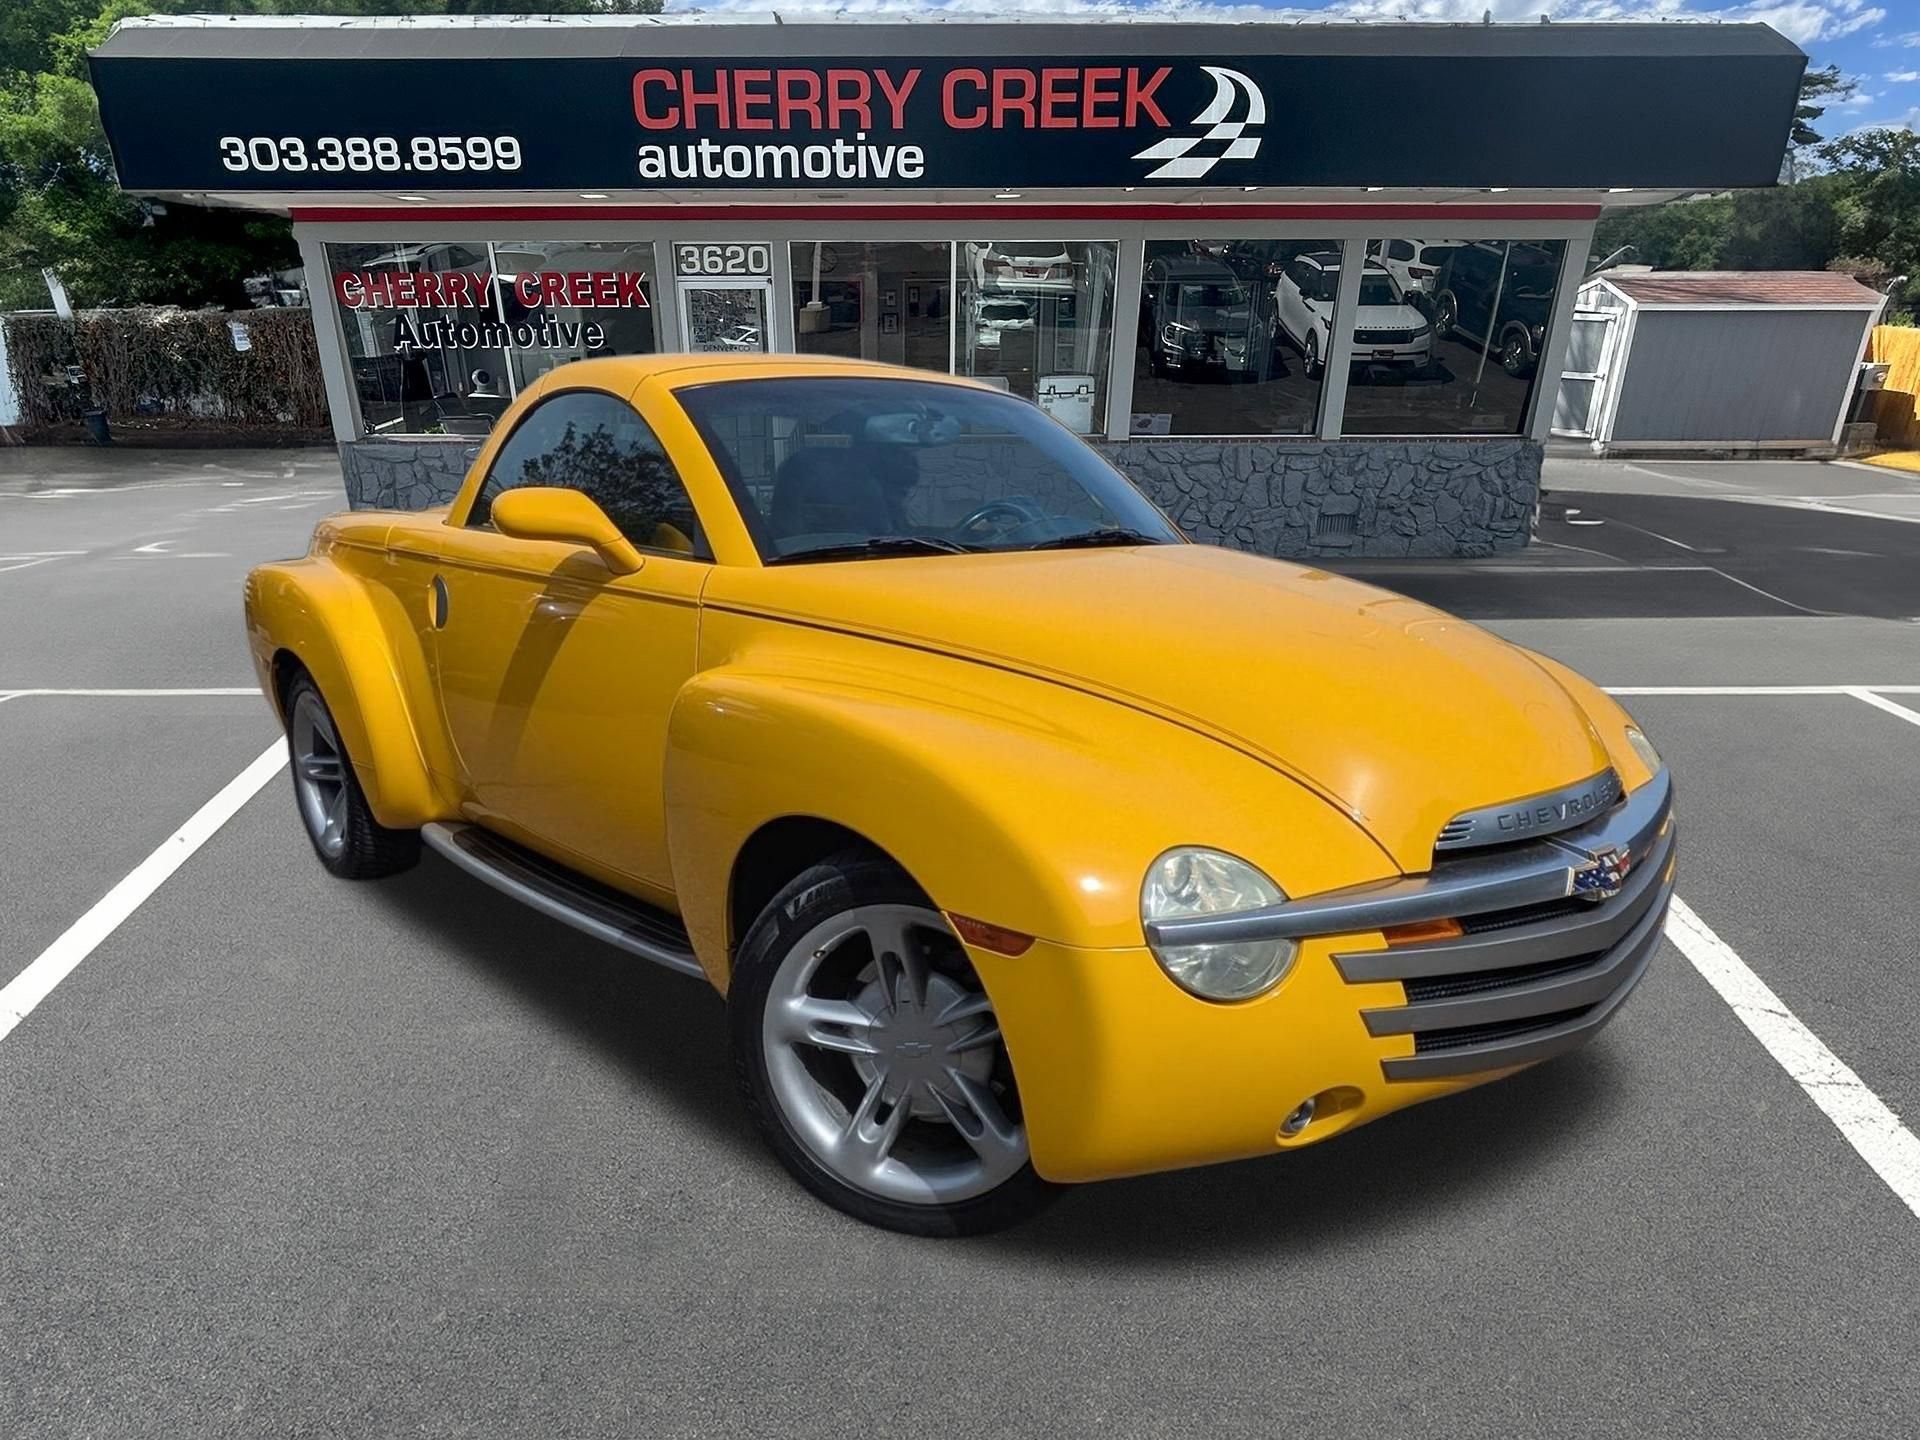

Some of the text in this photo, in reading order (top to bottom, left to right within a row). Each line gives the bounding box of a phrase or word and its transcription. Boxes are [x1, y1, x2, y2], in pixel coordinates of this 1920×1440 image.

[632, 67, 1173, 130] CHERRY CREEK
[219, 136, 522, 172] 303.388.8599
[638, 132, 924, 179] automotive
[680, 245, 769, 274] 3620
[335, 271, 651, 309] CHERRY CREEK
[393, 312, 606, 350] Automotive
